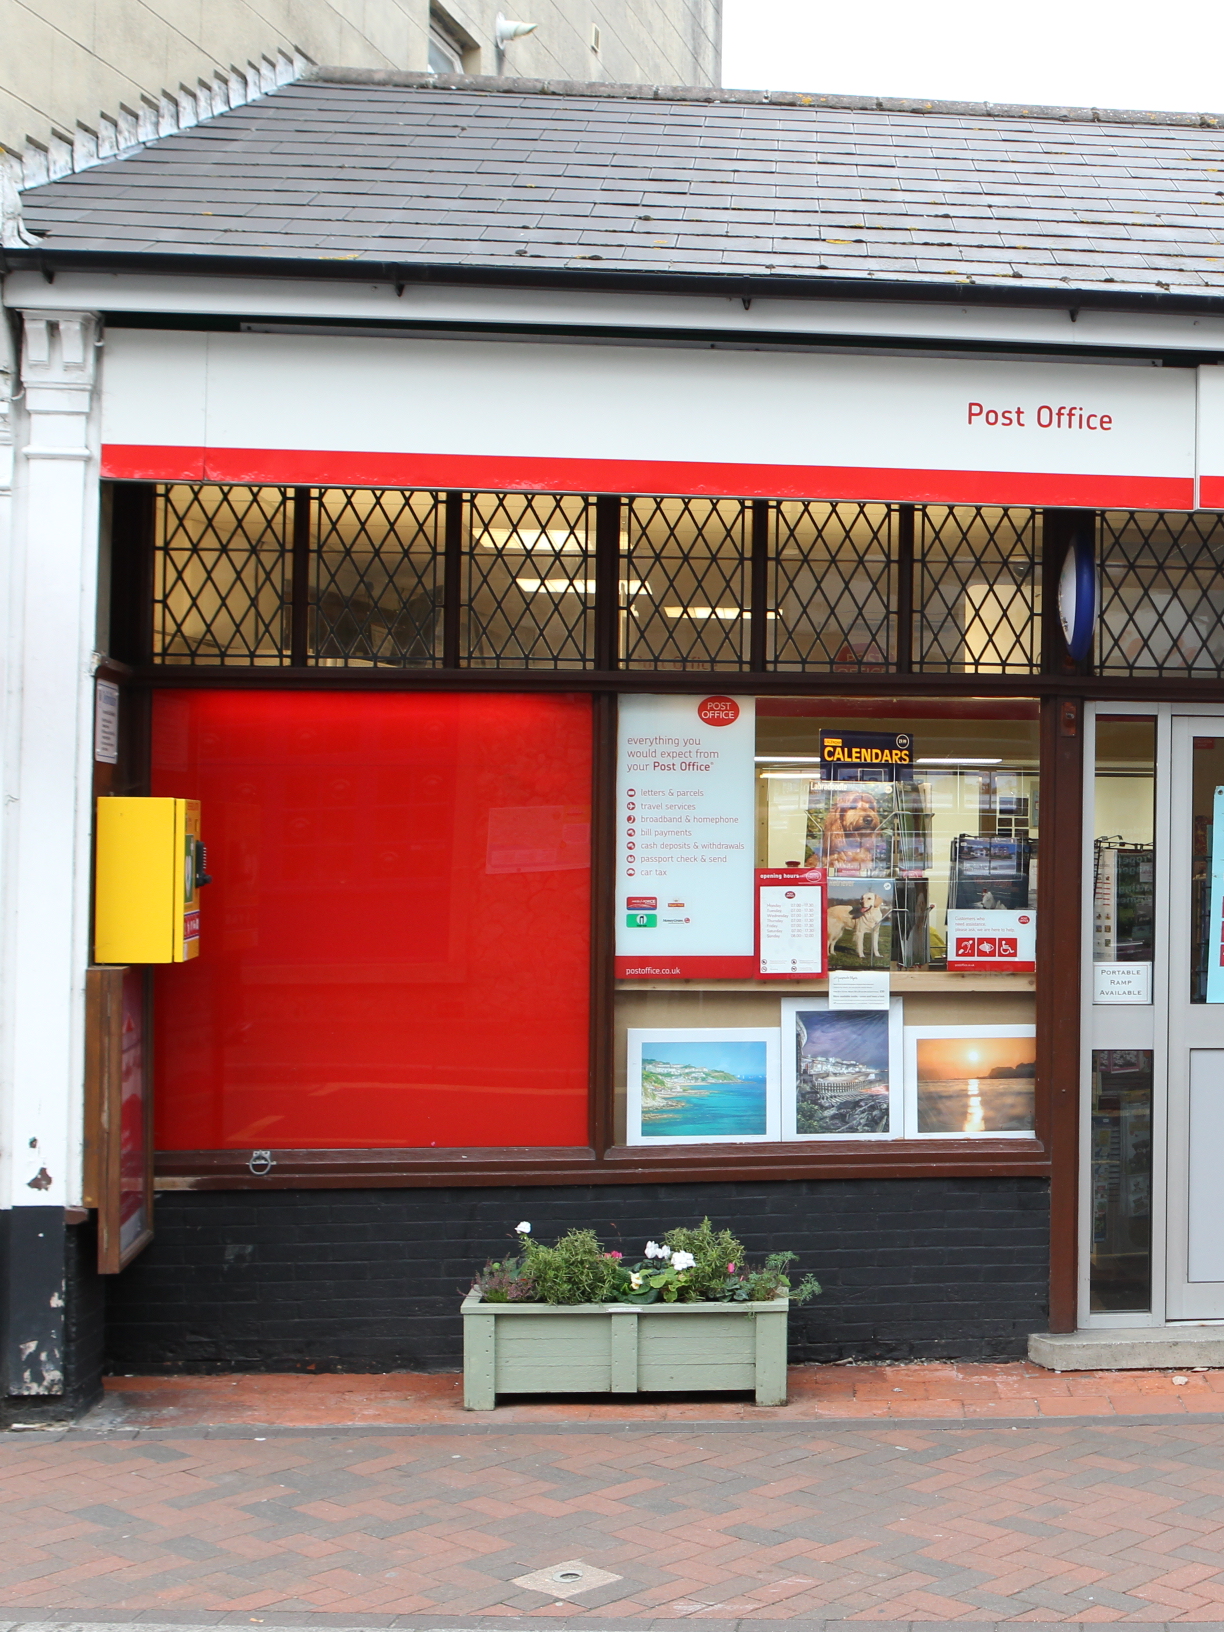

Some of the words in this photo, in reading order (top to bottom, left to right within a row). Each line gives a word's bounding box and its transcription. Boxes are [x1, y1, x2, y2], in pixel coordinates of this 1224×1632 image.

[967, 401, 1024, 428] Post
[1036, 404, 1113, 431] Office
[707, 702, 731, 710] POST
[701, 711, 735, 719] OFFICE
[627, 736, 679, 747] everything
[683, 738, 701, 747] you
[627, 749, 657, 758] would
[660, 750, 693, 759] expect
[695, 749, 719, 758] from
[824, 746, 910, 764] CALENDARS
[626, 763, 650, 773] your
[653, 761, 676, 771] Post
[810, 781, 847, 790] Labradoodle
[640, 789, 665, 797] letters
[668, 789, 674, 797] &
[676, 789, 704, 797] parcels
[640, 815, 682, 823] broadband
[685, 815, 691, 823] &
[693, 815, 739, 824] homephone
[654, 829, 692, 837] payments
[660, 842, 691, 850] deposits
[701, 842, 745, 850] withdrawals
[640, 855, 674, 863] passport
[676, 855, 698, 863] check
[700, 855, 706, 863] &
[708, 855, 727, 863] send
[626, 967, 680, 976] postoffice.co.uk
